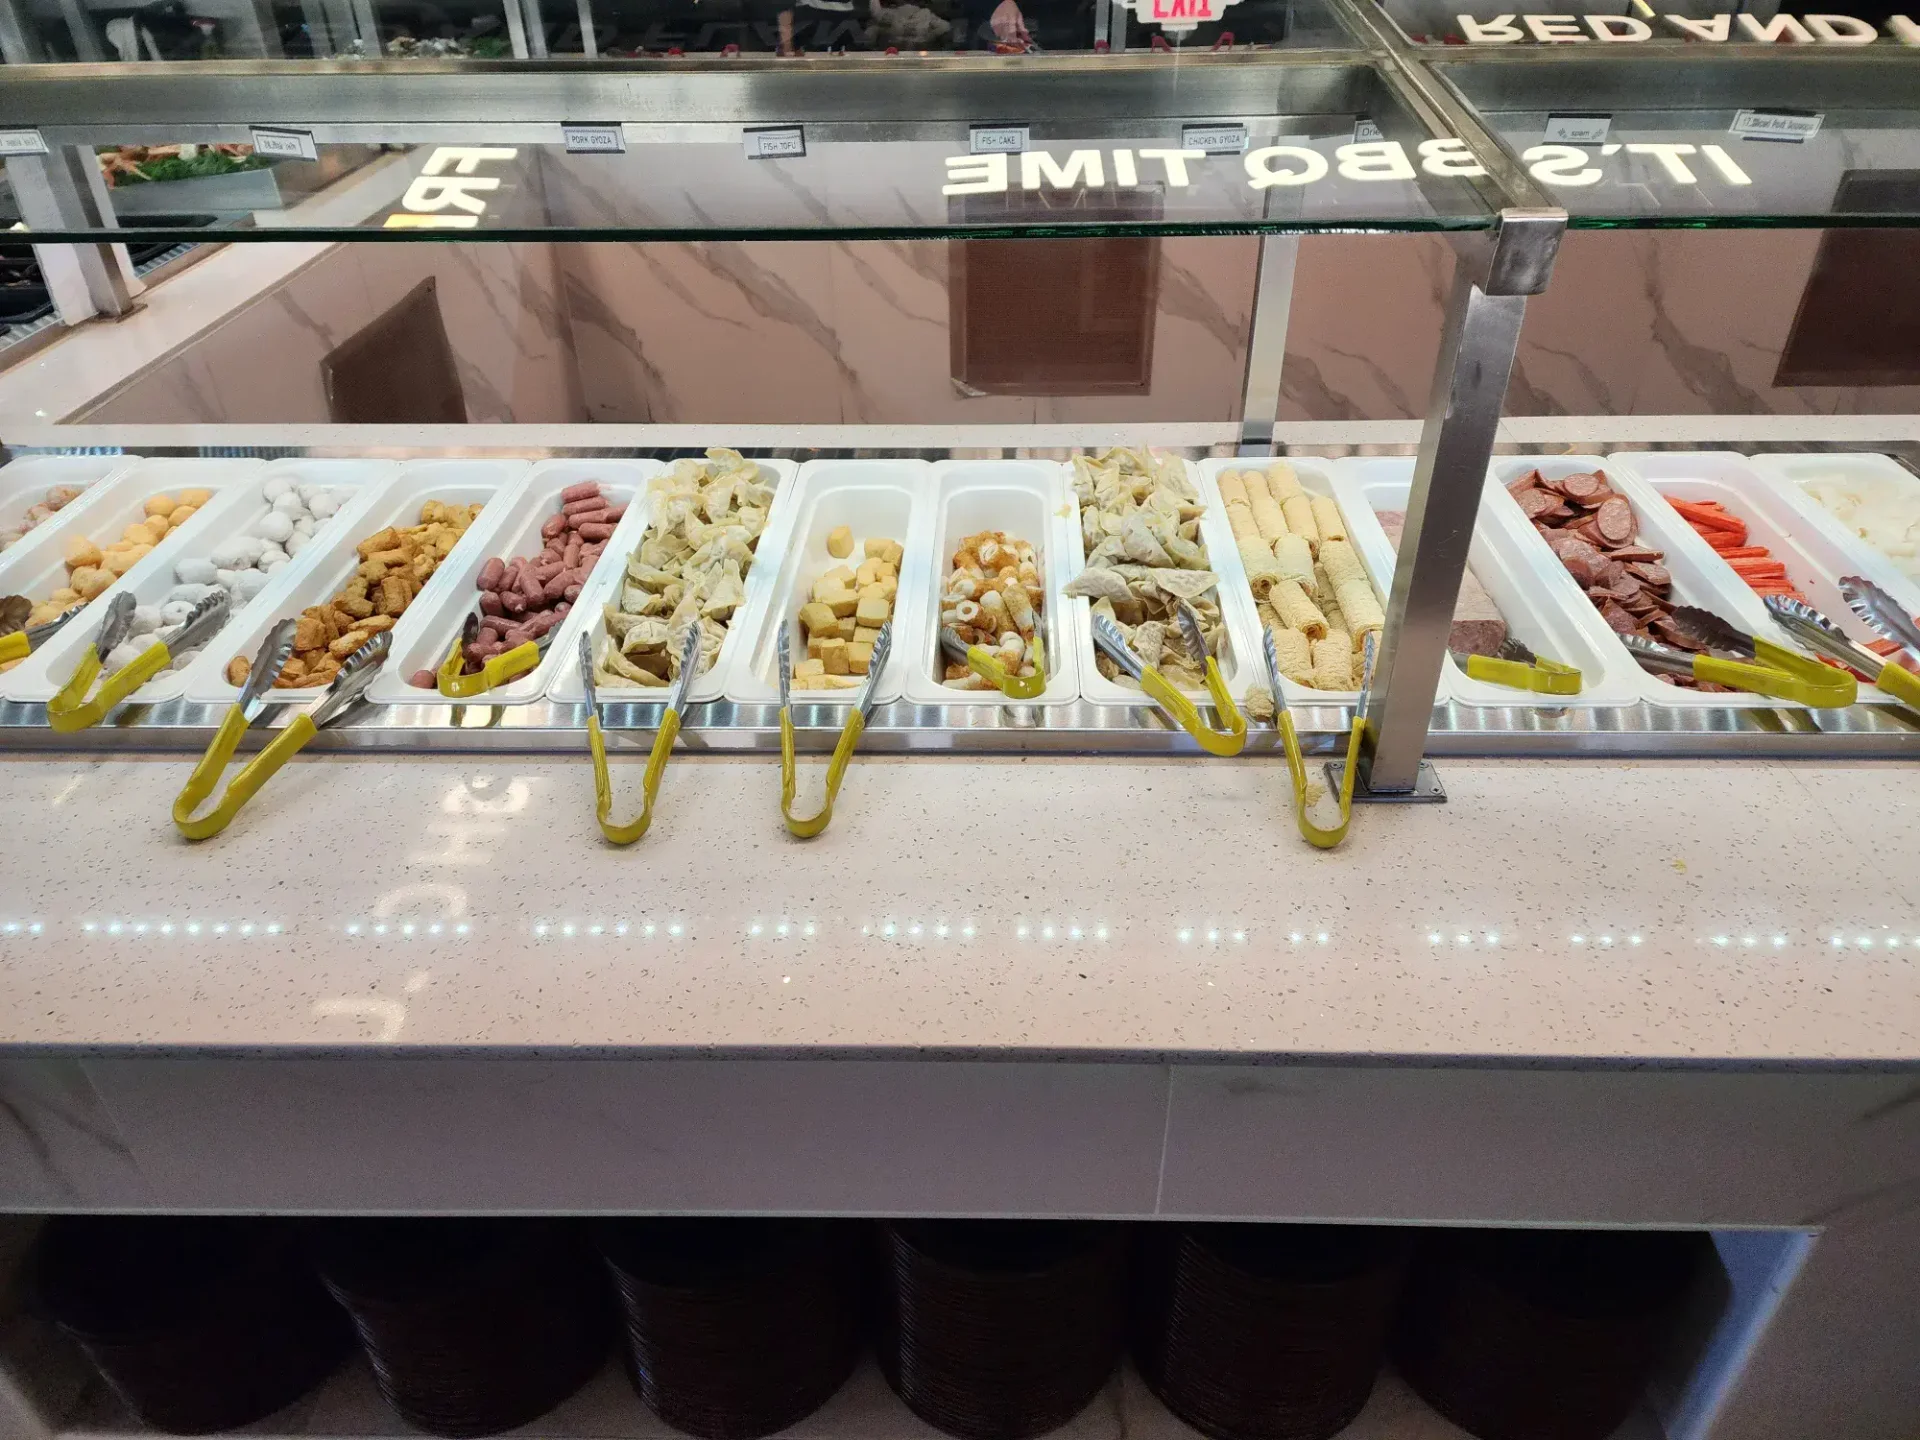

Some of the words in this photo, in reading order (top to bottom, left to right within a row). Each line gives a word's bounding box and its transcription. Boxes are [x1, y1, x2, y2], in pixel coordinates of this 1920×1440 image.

[571, 135, 589, 144] PORK
[590, 136, 613, 144] GYOZA
[998, 135, 1016, 145] CAKE
[1188, 136, 1217, 145] CHICKEN
[1219, 134, 1241, 144] GYOZA
[763, 142, 778, 151] FISH
[780, 141, 797, 150] TOFU
